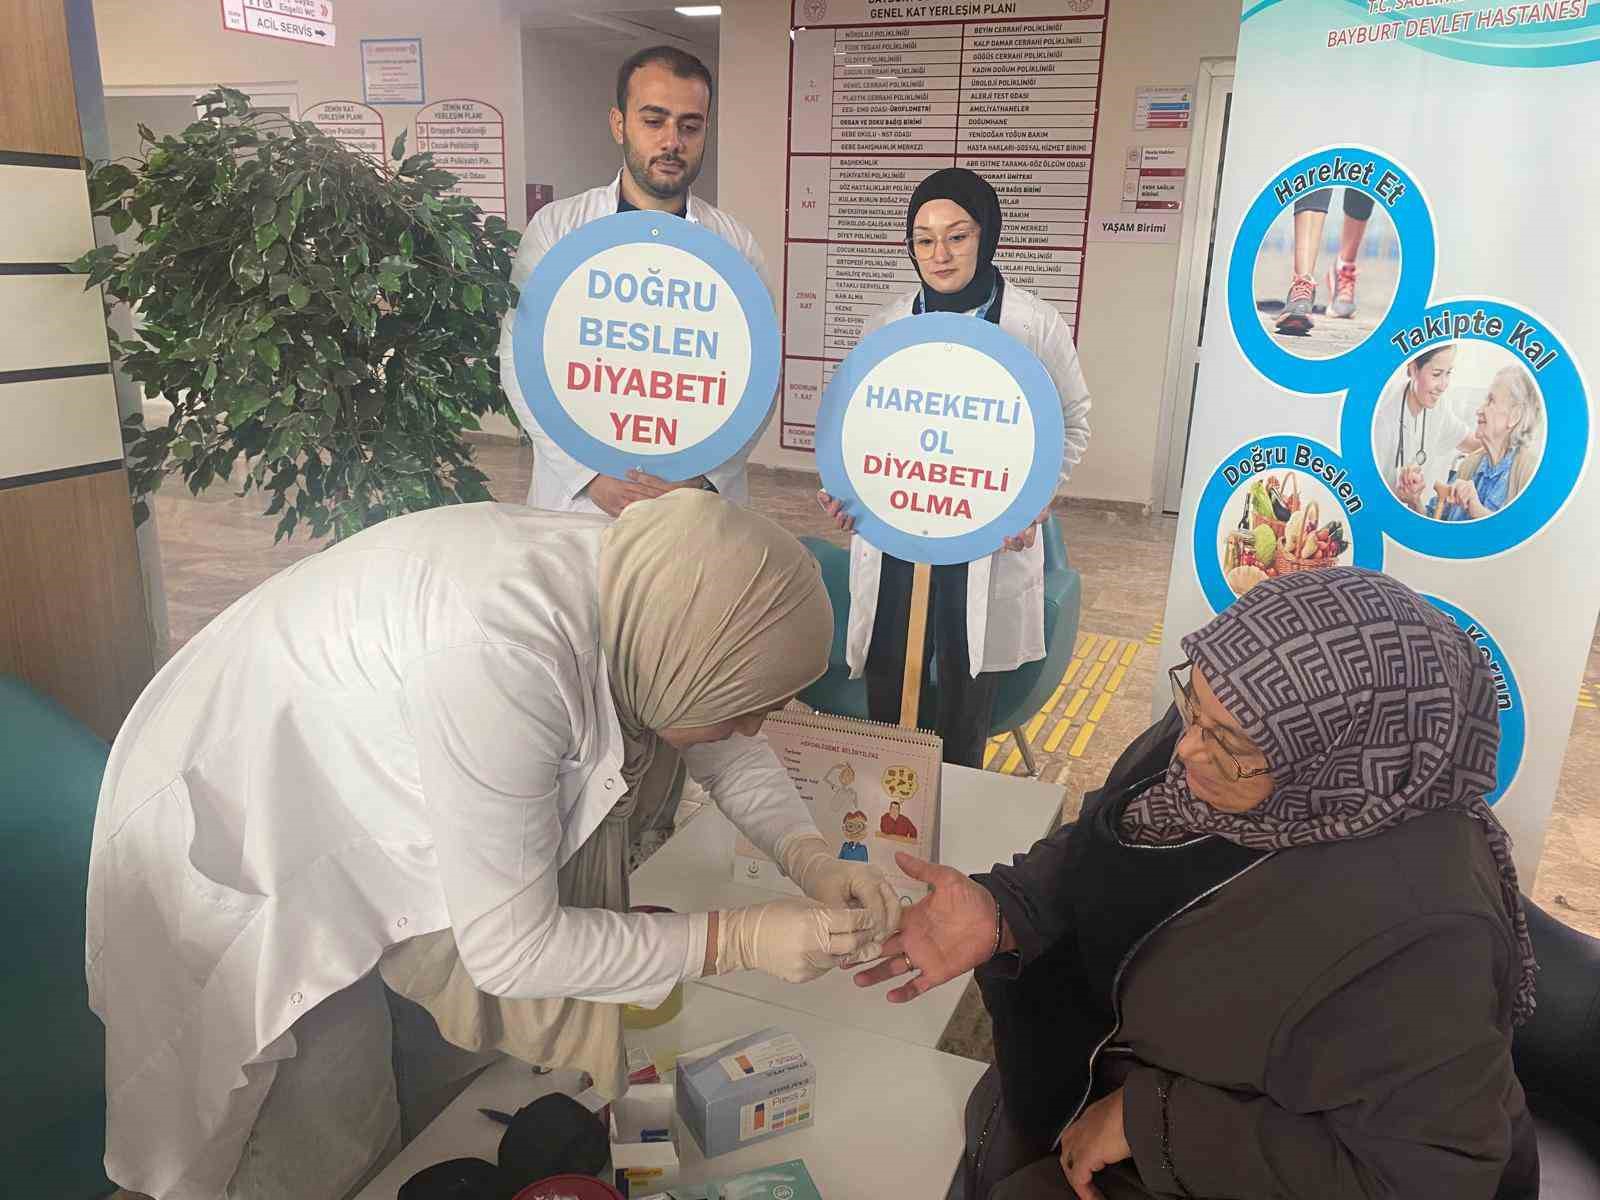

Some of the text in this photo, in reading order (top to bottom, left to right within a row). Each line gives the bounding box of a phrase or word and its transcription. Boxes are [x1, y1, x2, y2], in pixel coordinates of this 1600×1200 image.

[257, 17, 279, 31] ACİL
[281, 22, 313, 37] SERVİS
[870, 3, 1016, 18] GENEL KAT YERLEŞİM PLANI
[1328, 23, 1400, 47] BAYBURT
[1405, 13, 1472, 37] DEVLET
[1274, 157, 1406, 206] Hareket Et
[801, 200, 816, 208] KAT
[1102, 223, 1166, 234] YAŞAM Birimi
[588, 267, 717, 312] DOĞRU
[579, 316, 718, 360] BESLEN
[1391, 311, 1556, 371] Takipte Kal
[567, 357, 727, 406] DİYABETİ
[865, 385, 1021, 425] HAREKETLİ
[609, 411, 678, 446] YEN
[920, 428, 954, 455] OL
[863, 452, 1009, 493] DİYABETLİ
[1223, 445, 1364, 513] Doğru Beslen
[890, 490, 973, 519] OLMA
